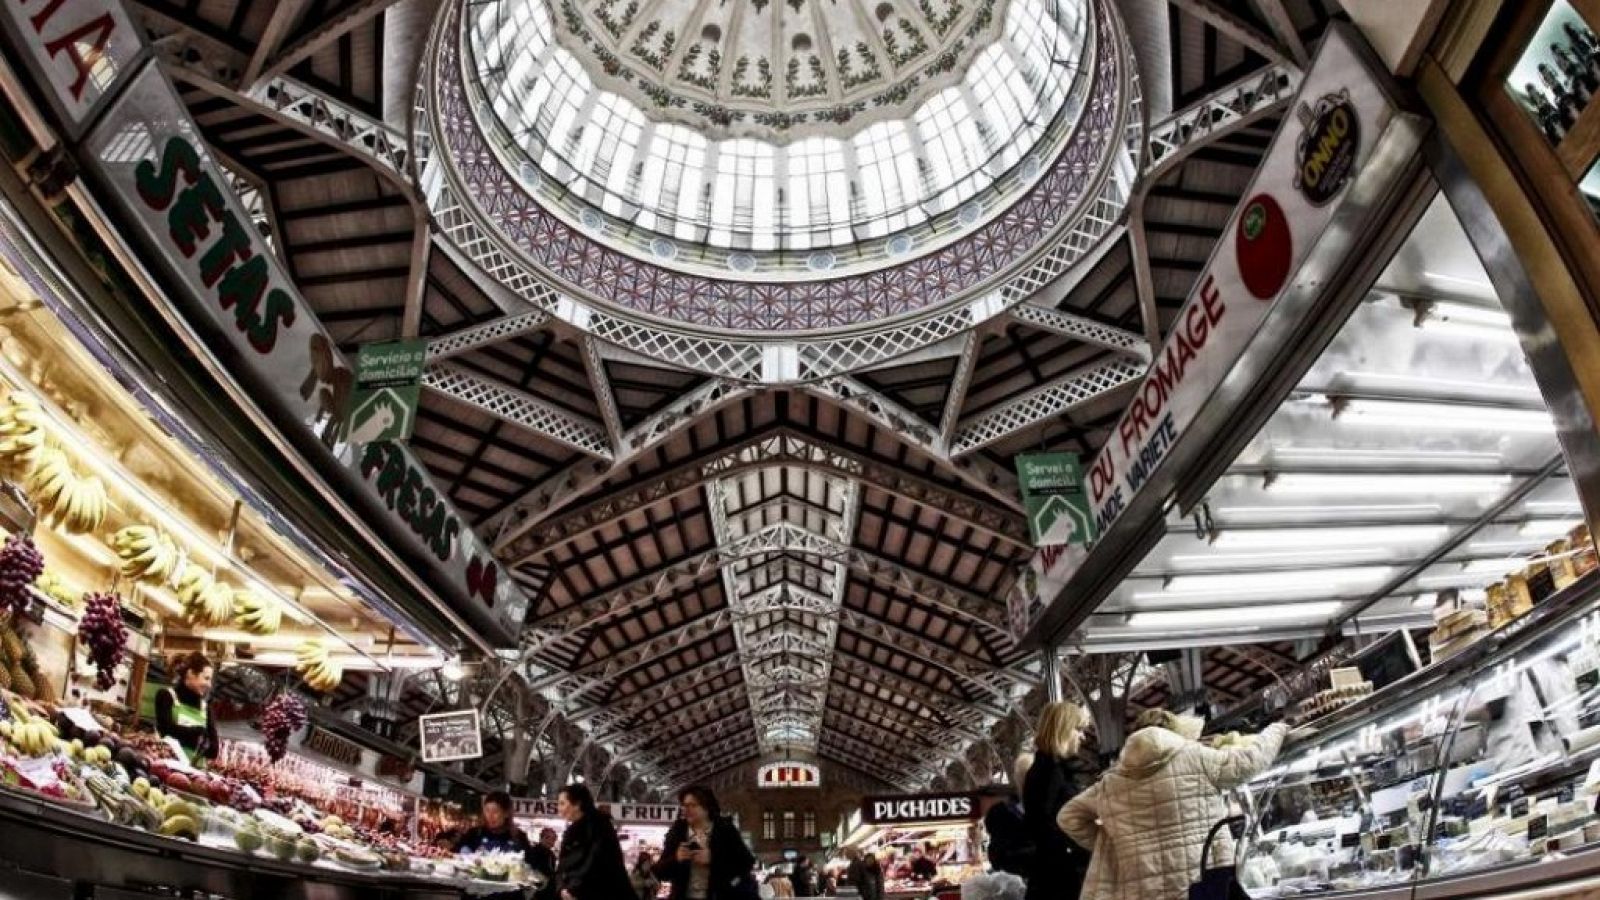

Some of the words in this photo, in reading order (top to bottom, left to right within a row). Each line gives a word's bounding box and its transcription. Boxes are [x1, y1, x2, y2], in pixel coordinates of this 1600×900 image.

[135, 136, 295, 354] SETAS
[1089, 447, 1115, 503] DU
[1119, 275, 1226, 458] FROMAGE
[361, 440, 460, 561] FRESAS
[1096, 486, 1126, 535] ANDE
[1125, 410, 1178, 492] VARIETE
[513, 799, 559, 815] UTAS
[621, 805, 677, 820] FRUT
[874, 797, 972, 819] PUCHADES
